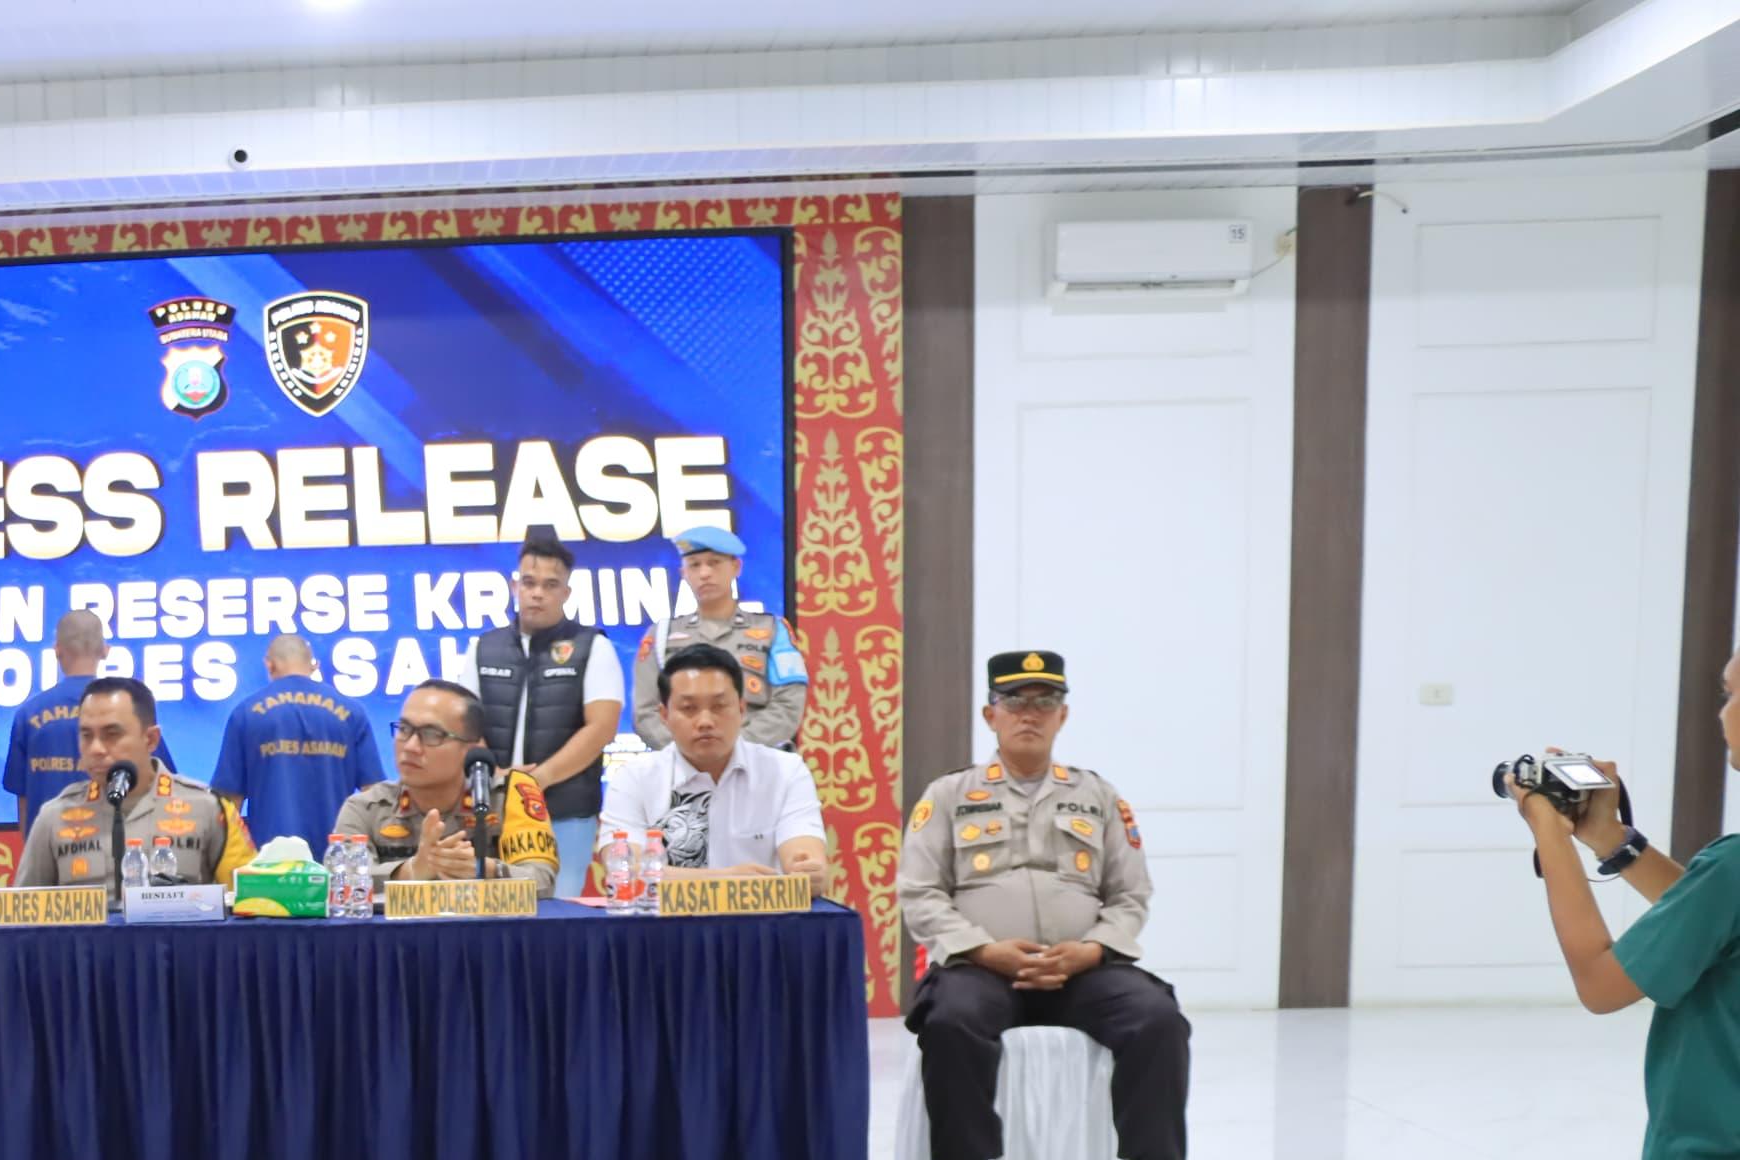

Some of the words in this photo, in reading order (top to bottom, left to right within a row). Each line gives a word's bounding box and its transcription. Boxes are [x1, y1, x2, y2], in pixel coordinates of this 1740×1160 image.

[196, 436, 736, 552] RELEASE
[70, 573, 389, 639] RESERSE
[414, 568, 765, 630] KRMIN
[29, 704, 81, 730] TAHA
[252, 691, 351, 721] TAHANAN
[58, 839, 102, 857] AFDHAL
[43, 891, 104, 921] ASAHAN
[388, 884, 426, 915] WAKA
[430, 884, 479, 913] POLRES
[483, 882, 536, 913] ASAHAN
[660, 881, 720, 913] KASAT
[726, 877, 809, 910] RESKRIM
